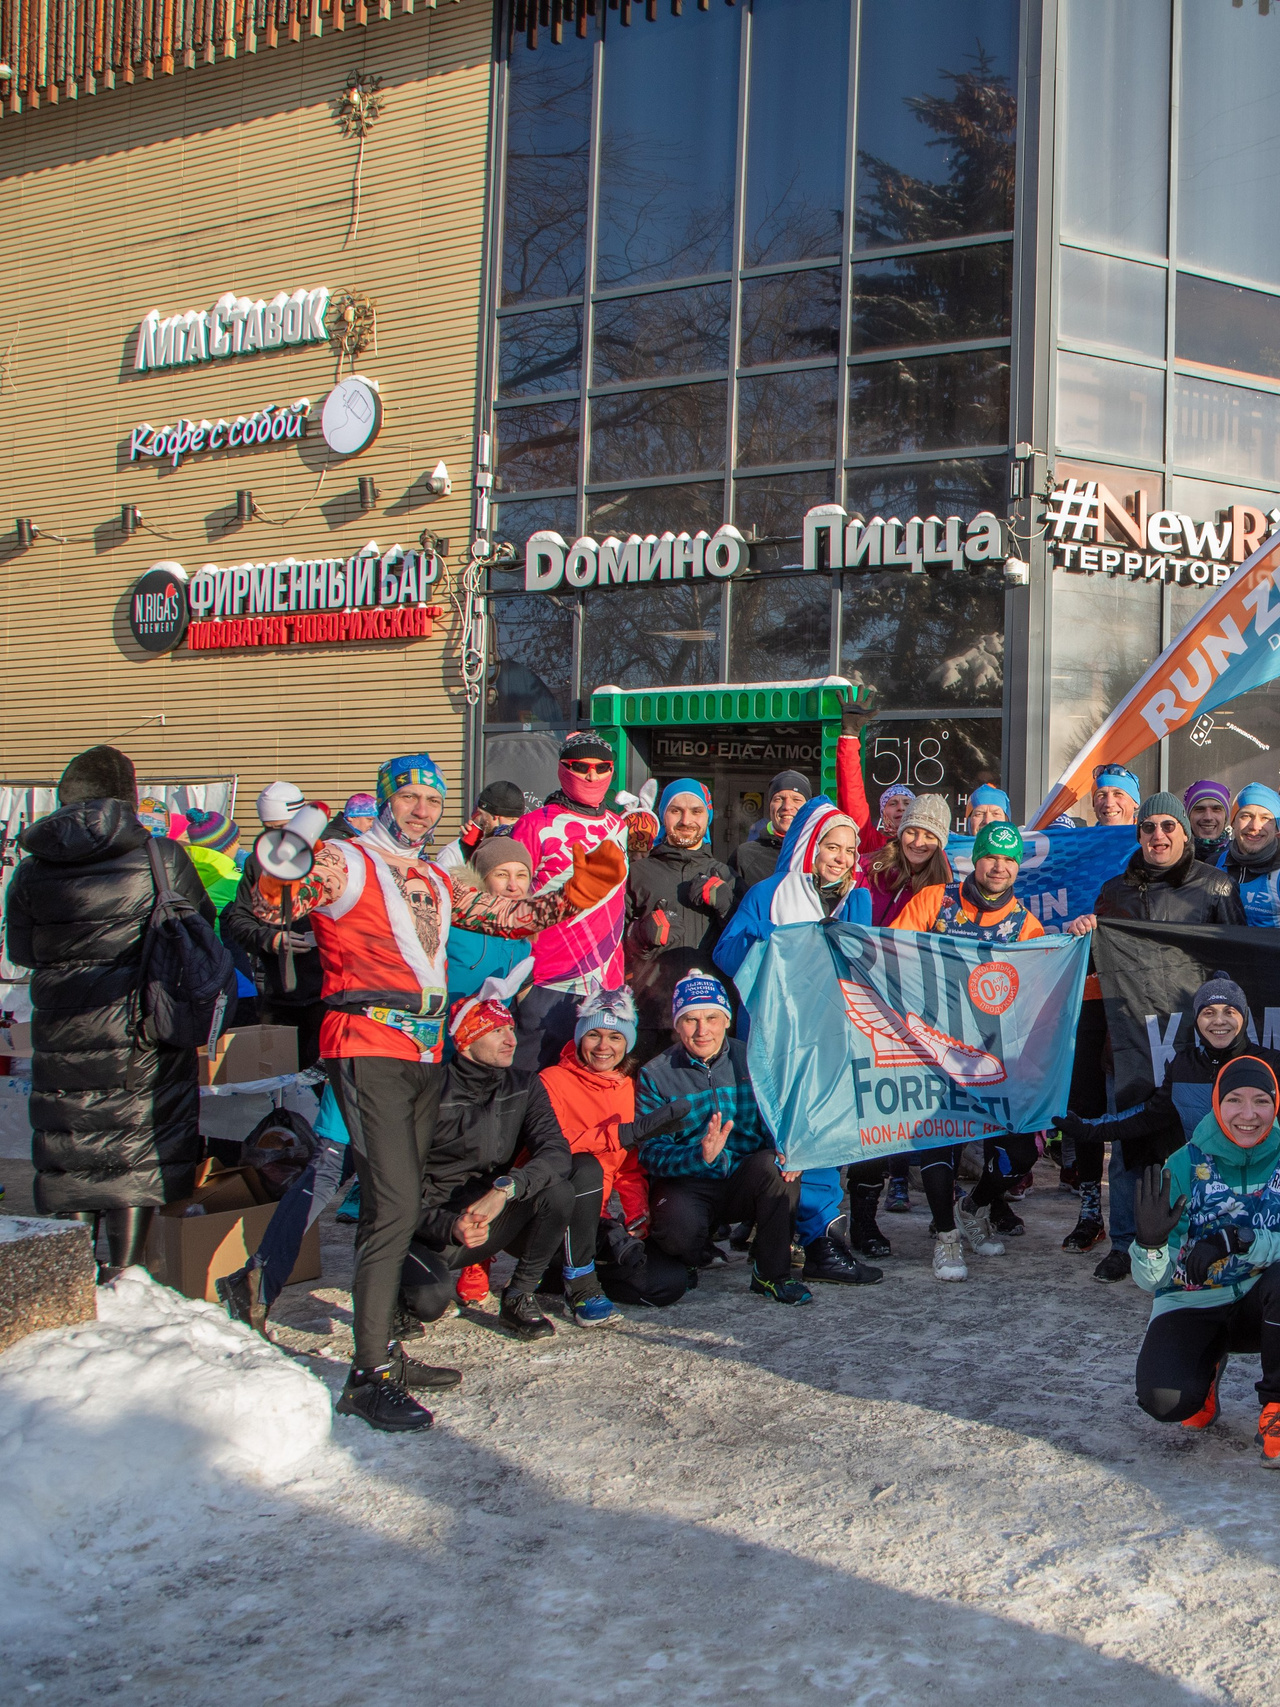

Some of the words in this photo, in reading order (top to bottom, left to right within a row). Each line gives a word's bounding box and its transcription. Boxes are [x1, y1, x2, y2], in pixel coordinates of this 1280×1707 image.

[803, 507, 1003, 574] Пицца
[189, 550, 378, 617] ФИРМЕННЫЙ
[378, 548, 438, 606] БАР
[138, 620, 176, 635] BREWERY
[1139, 612, 1249, 741] RUN
[656, 740, 709, 757] ПИВО
[717, 742, 755, 760] ЕДА
[859, 1119, 976, 1147] NON-ALCOHOLIC
